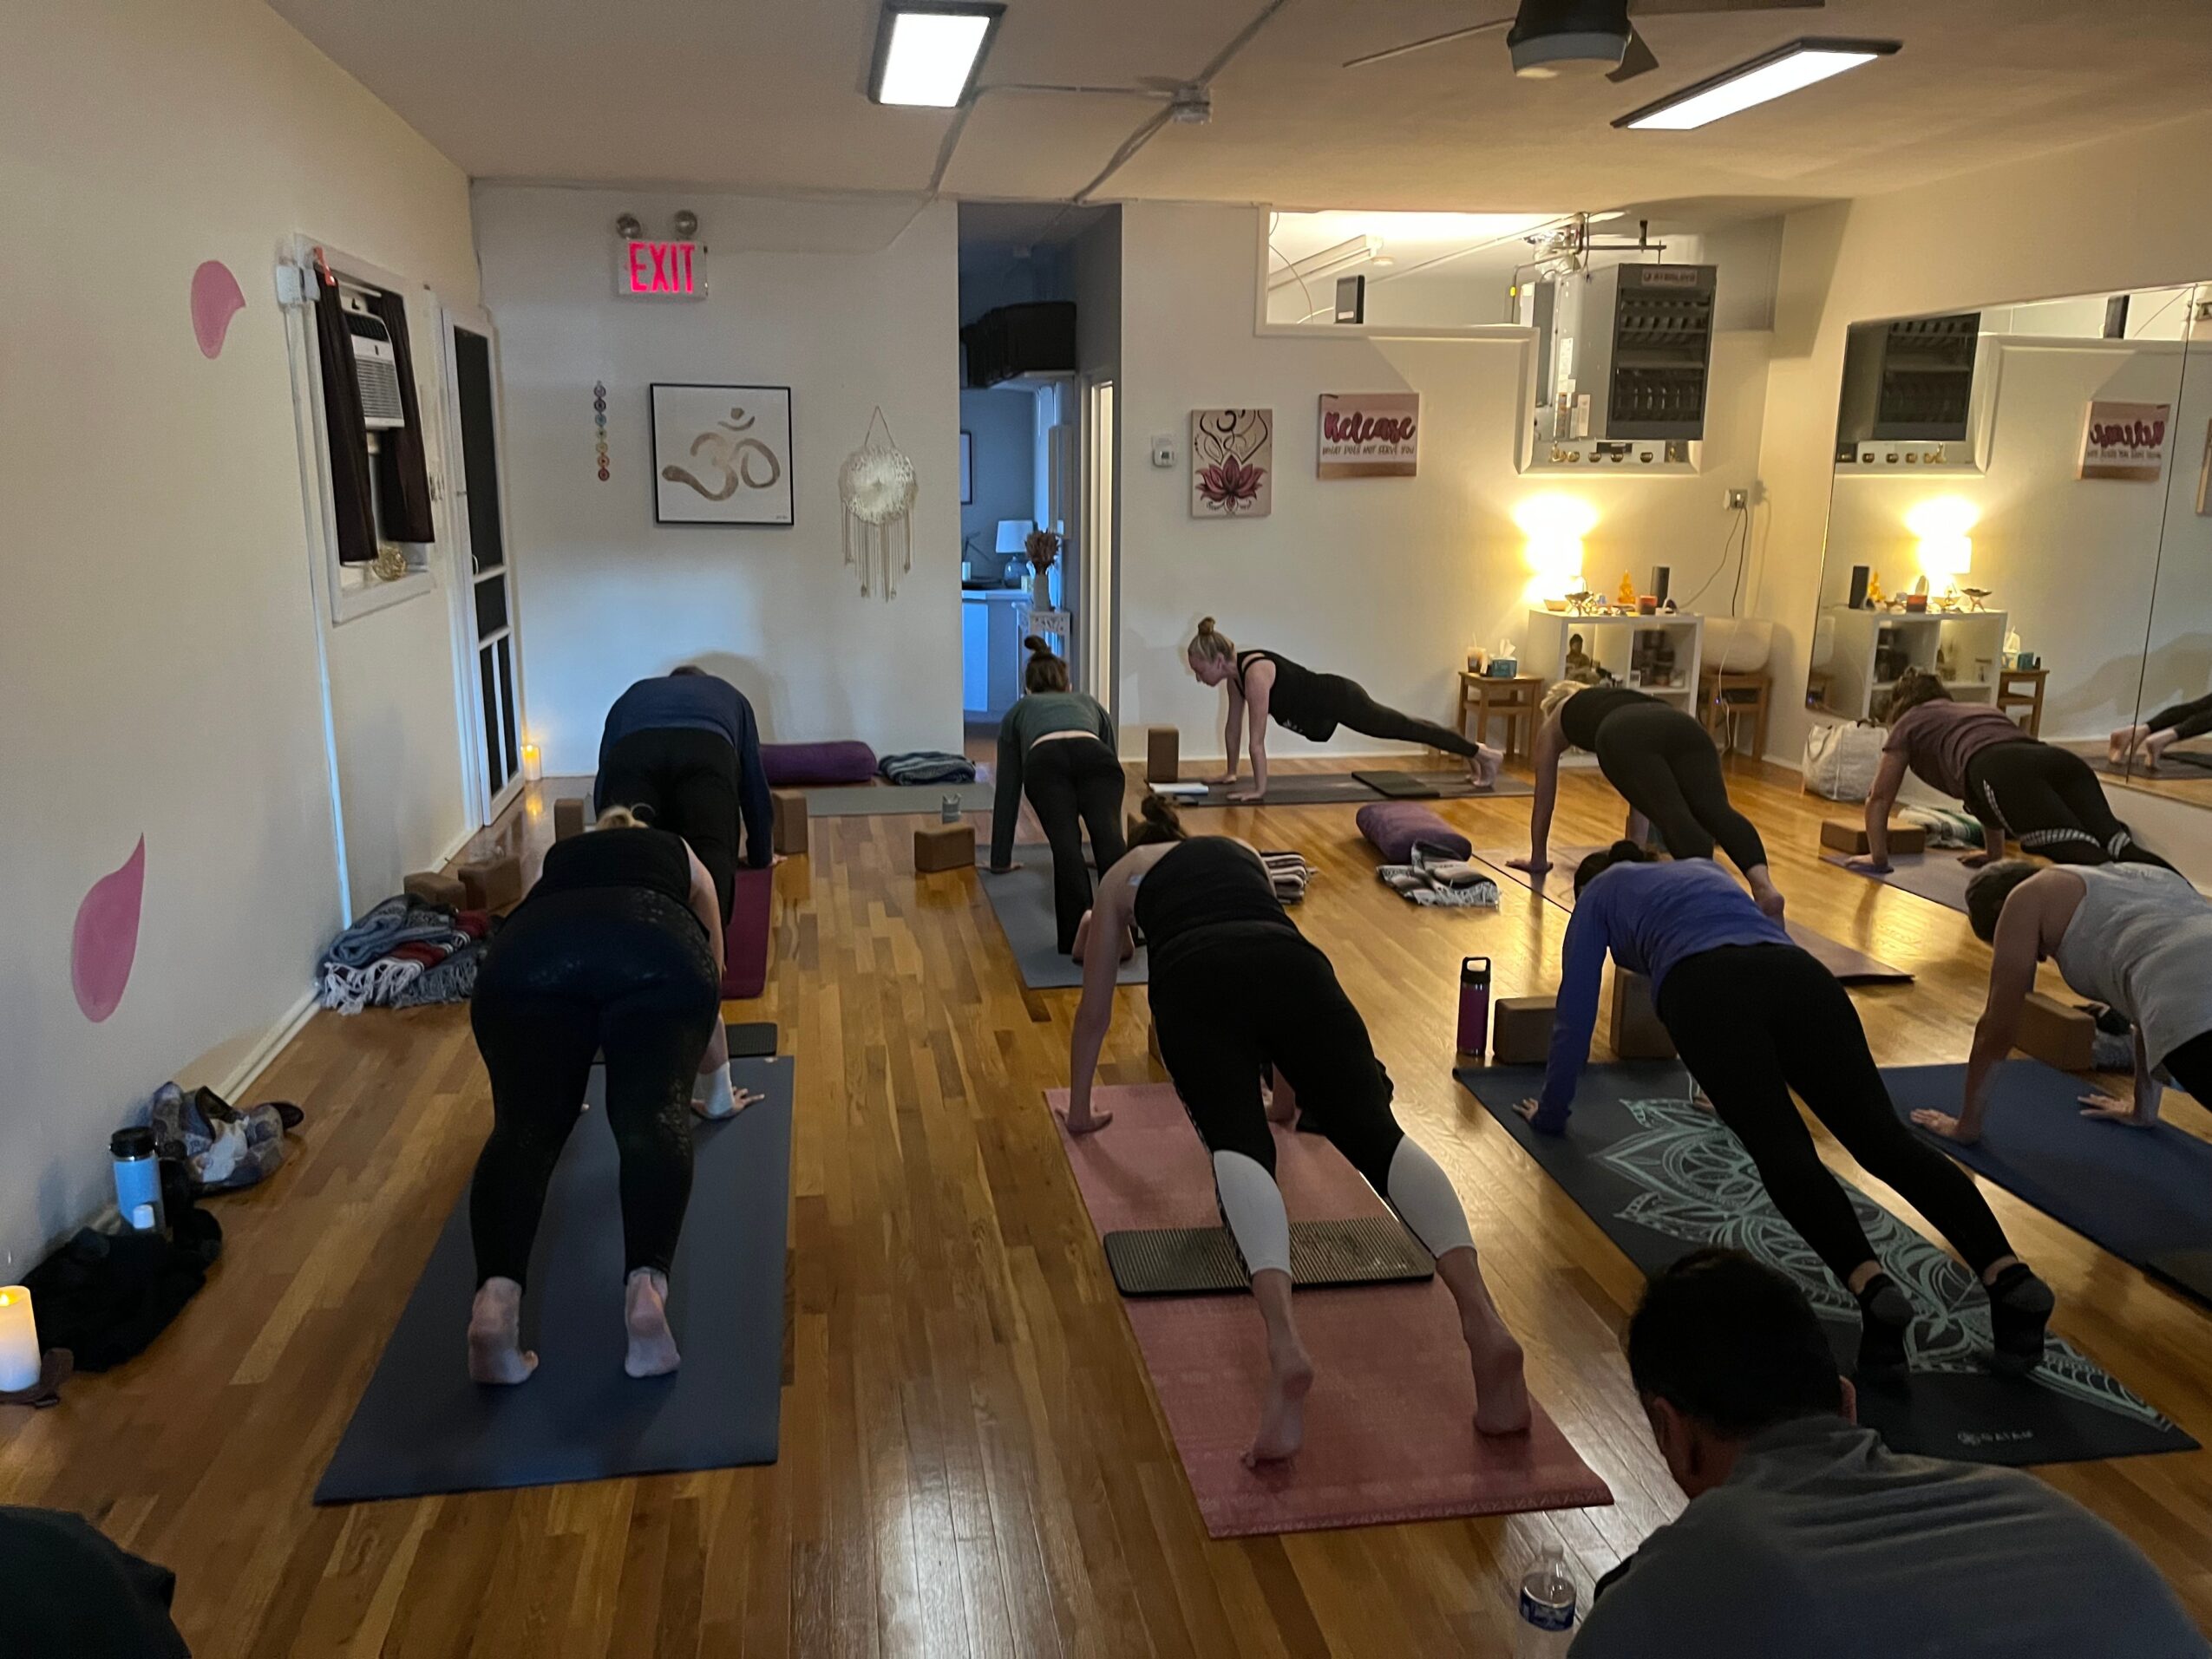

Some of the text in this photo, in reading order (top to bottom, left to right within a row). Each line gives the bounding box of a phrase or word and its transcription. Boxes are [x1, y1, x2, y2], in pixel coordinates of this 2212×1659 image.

[630, 242, 695, 293] EXIT
[1324, 411, 1416, 444] Release
[1363, 445, 1377, 455] NOT
[1401, 445, 1415, 455] YOU
